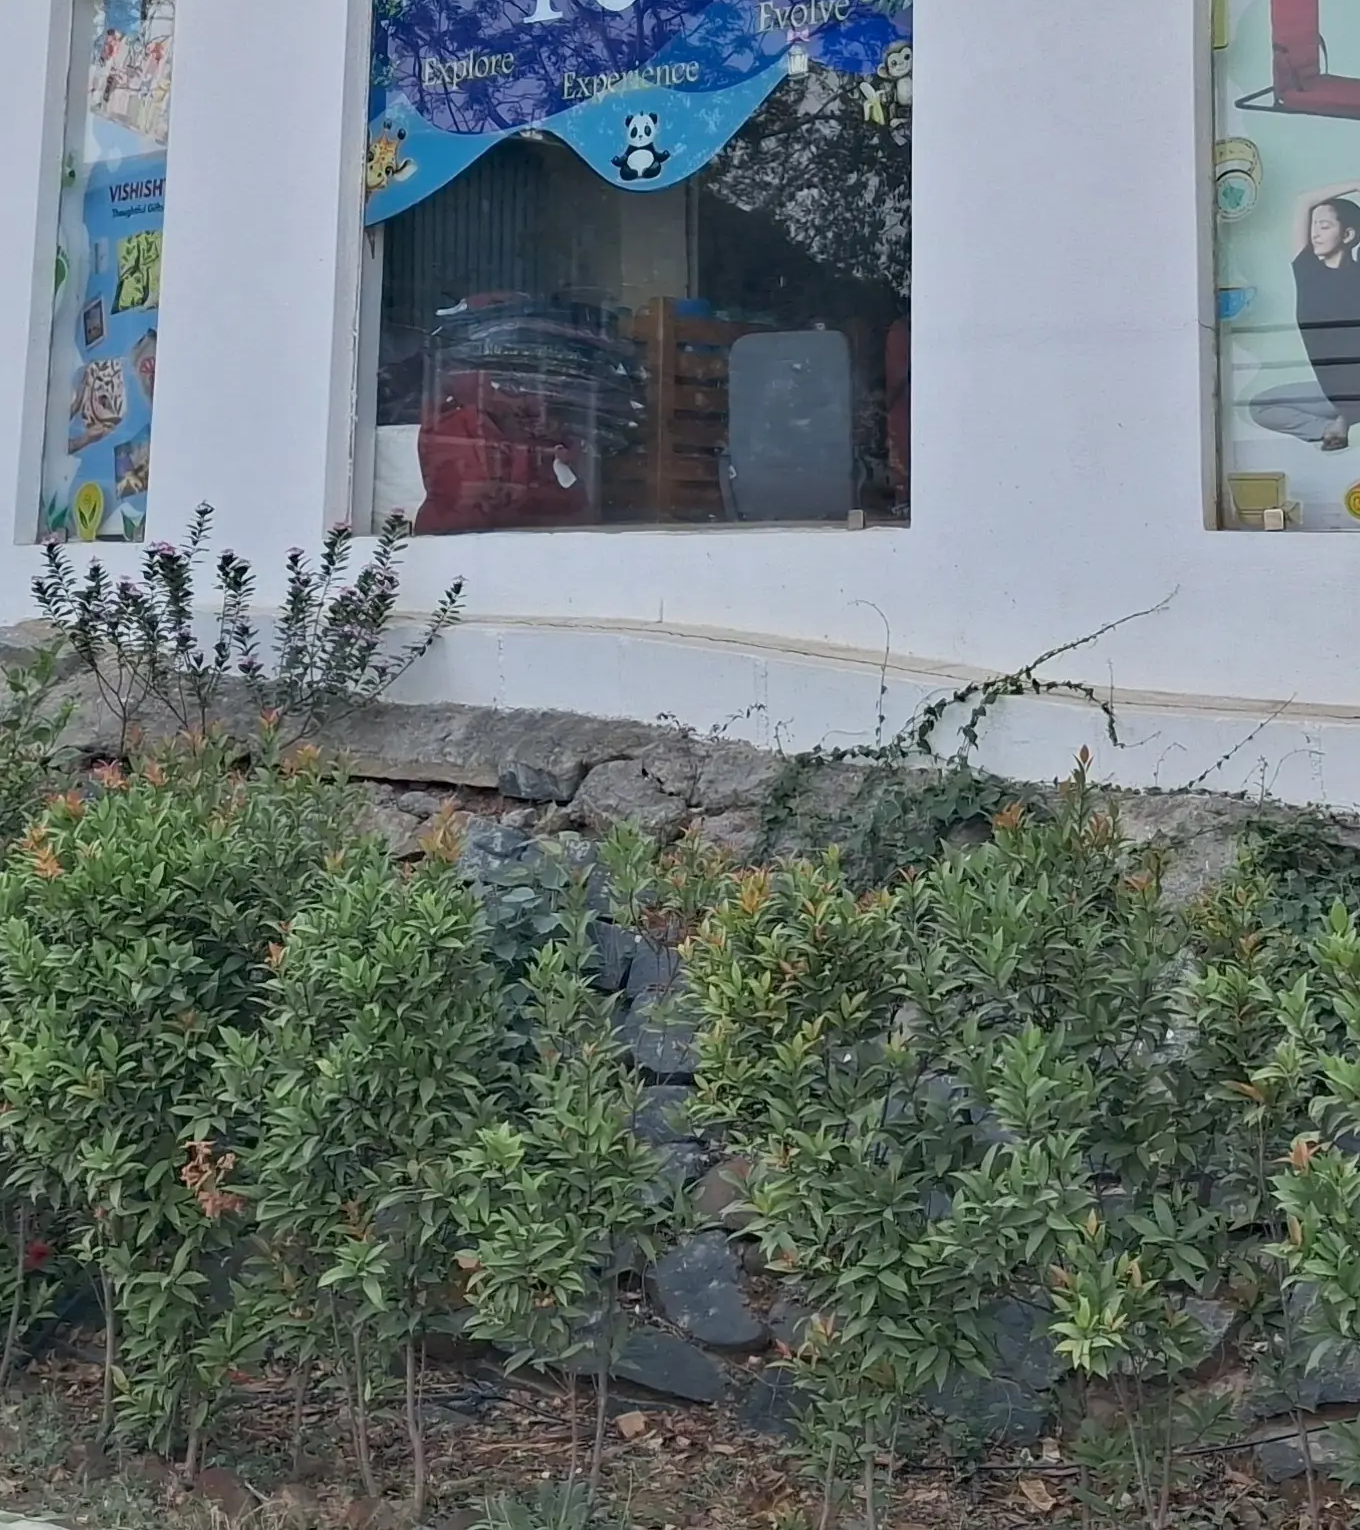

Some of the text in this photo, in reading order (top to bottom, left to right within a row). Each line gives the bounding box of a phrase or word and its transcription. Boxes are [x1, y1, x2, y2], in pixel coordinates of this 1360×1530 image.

[422, 49, 515, 87] Explore
[562, 57, 700, 101] Experience
[109, 177, 167, 203] VISHISH
